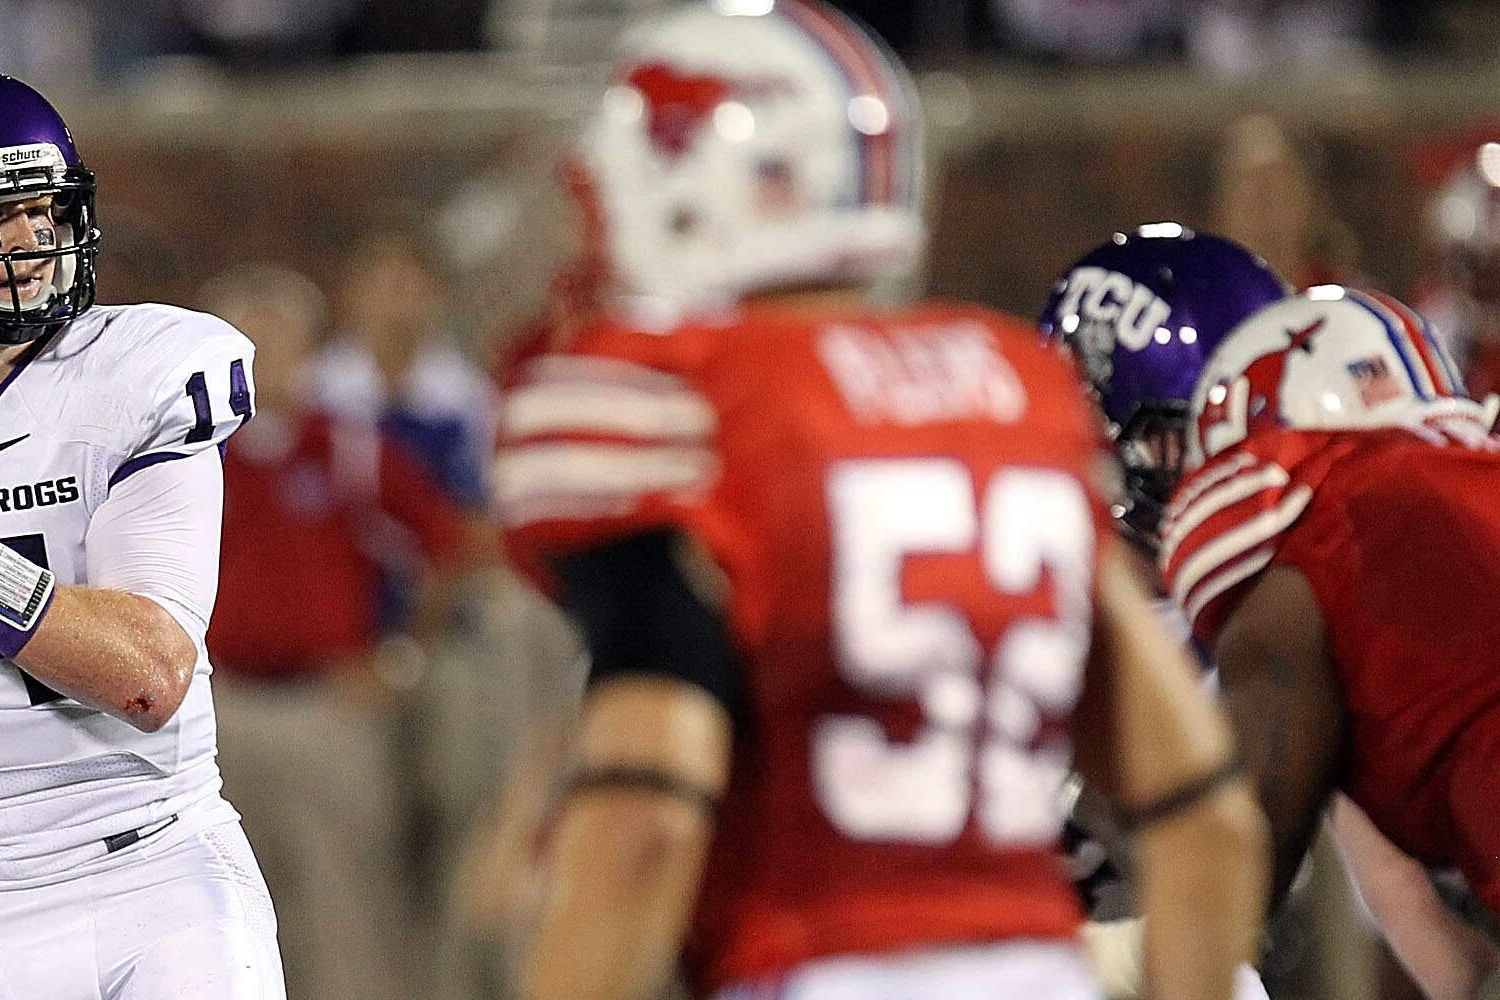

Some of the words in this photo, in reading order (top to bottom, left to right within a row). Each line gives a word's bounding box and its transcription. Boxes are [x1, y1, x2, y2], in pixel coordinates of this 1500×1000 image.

[1, 149, 41, 164] schutt
[1057, 265, 1172, 352] TCU
[184, 357, 253, 445] 14
[808, 453, 1096, 848] 52
